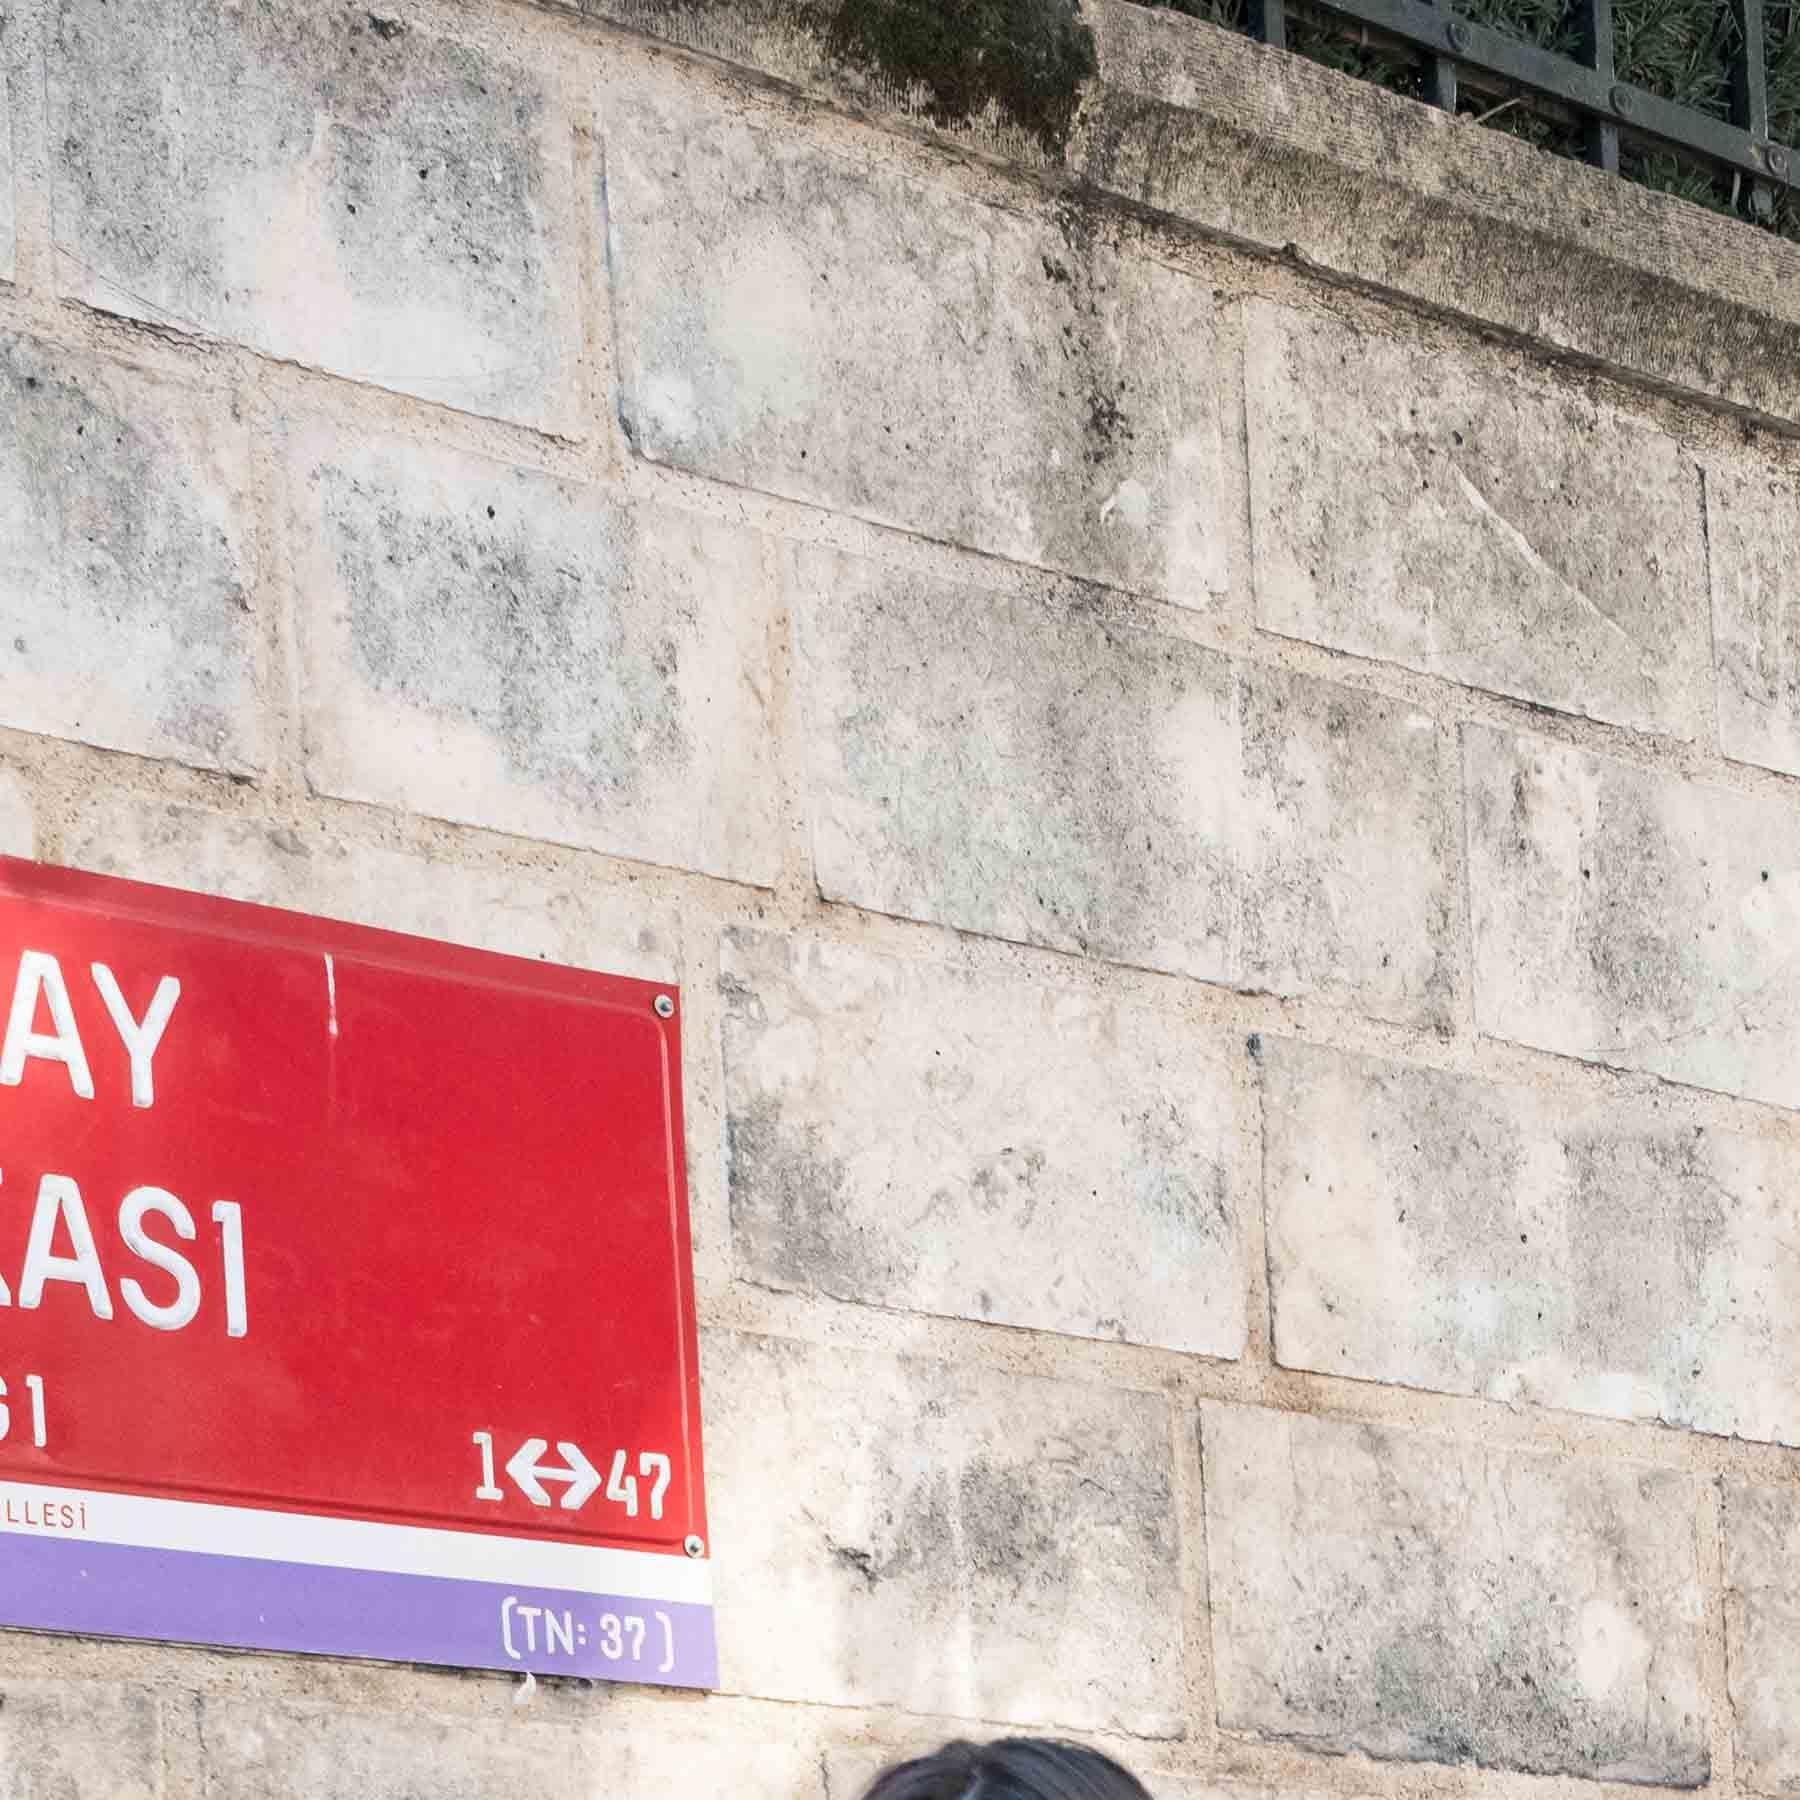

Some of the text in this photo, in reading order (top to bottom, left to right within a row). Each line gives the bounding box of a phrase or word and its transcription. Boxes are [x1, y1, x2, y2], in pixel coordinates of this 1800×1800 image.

[0, 949, 181, 1108] AY
[0, 1167, 247, 1338] ASI
[473, 1431, 671, 1520] 1 47
[501, 1596, 587, 1661] (TN:
